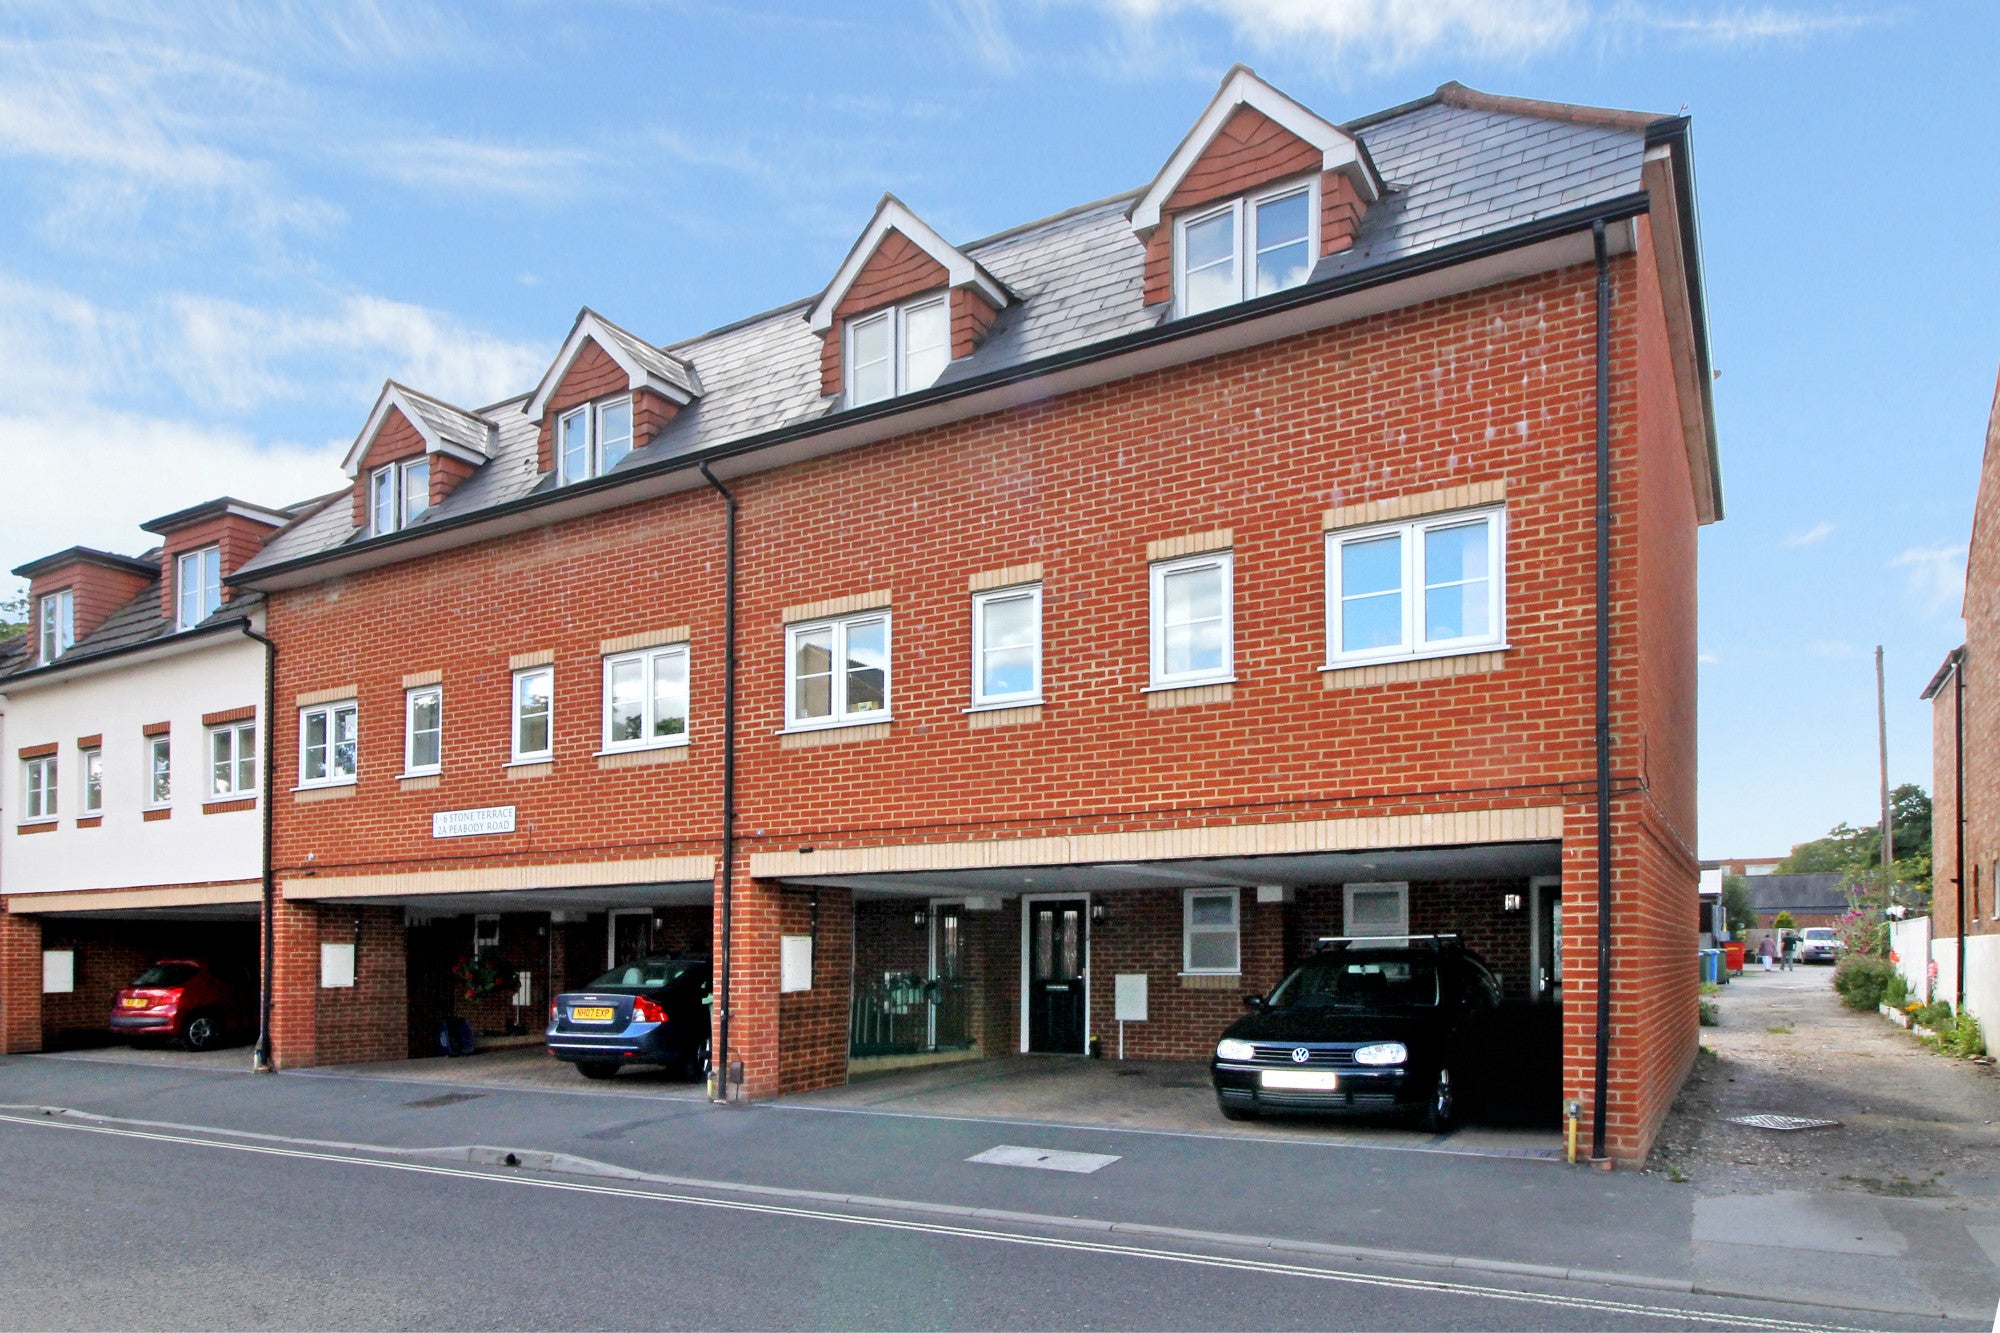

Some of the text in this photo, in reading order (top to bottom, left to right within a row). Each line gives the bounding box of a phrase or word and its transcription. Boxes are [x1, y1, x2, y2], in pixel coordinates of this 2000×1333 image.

[450, 812, 474, 823] STONE
[477, 808, 512, 820] TERRACE
[438, 820, 510, 835] 2A PEABODY ROAD
[577, 1008, 594, 1017] NH07
[596, 1008, 610, 1018] EXP
